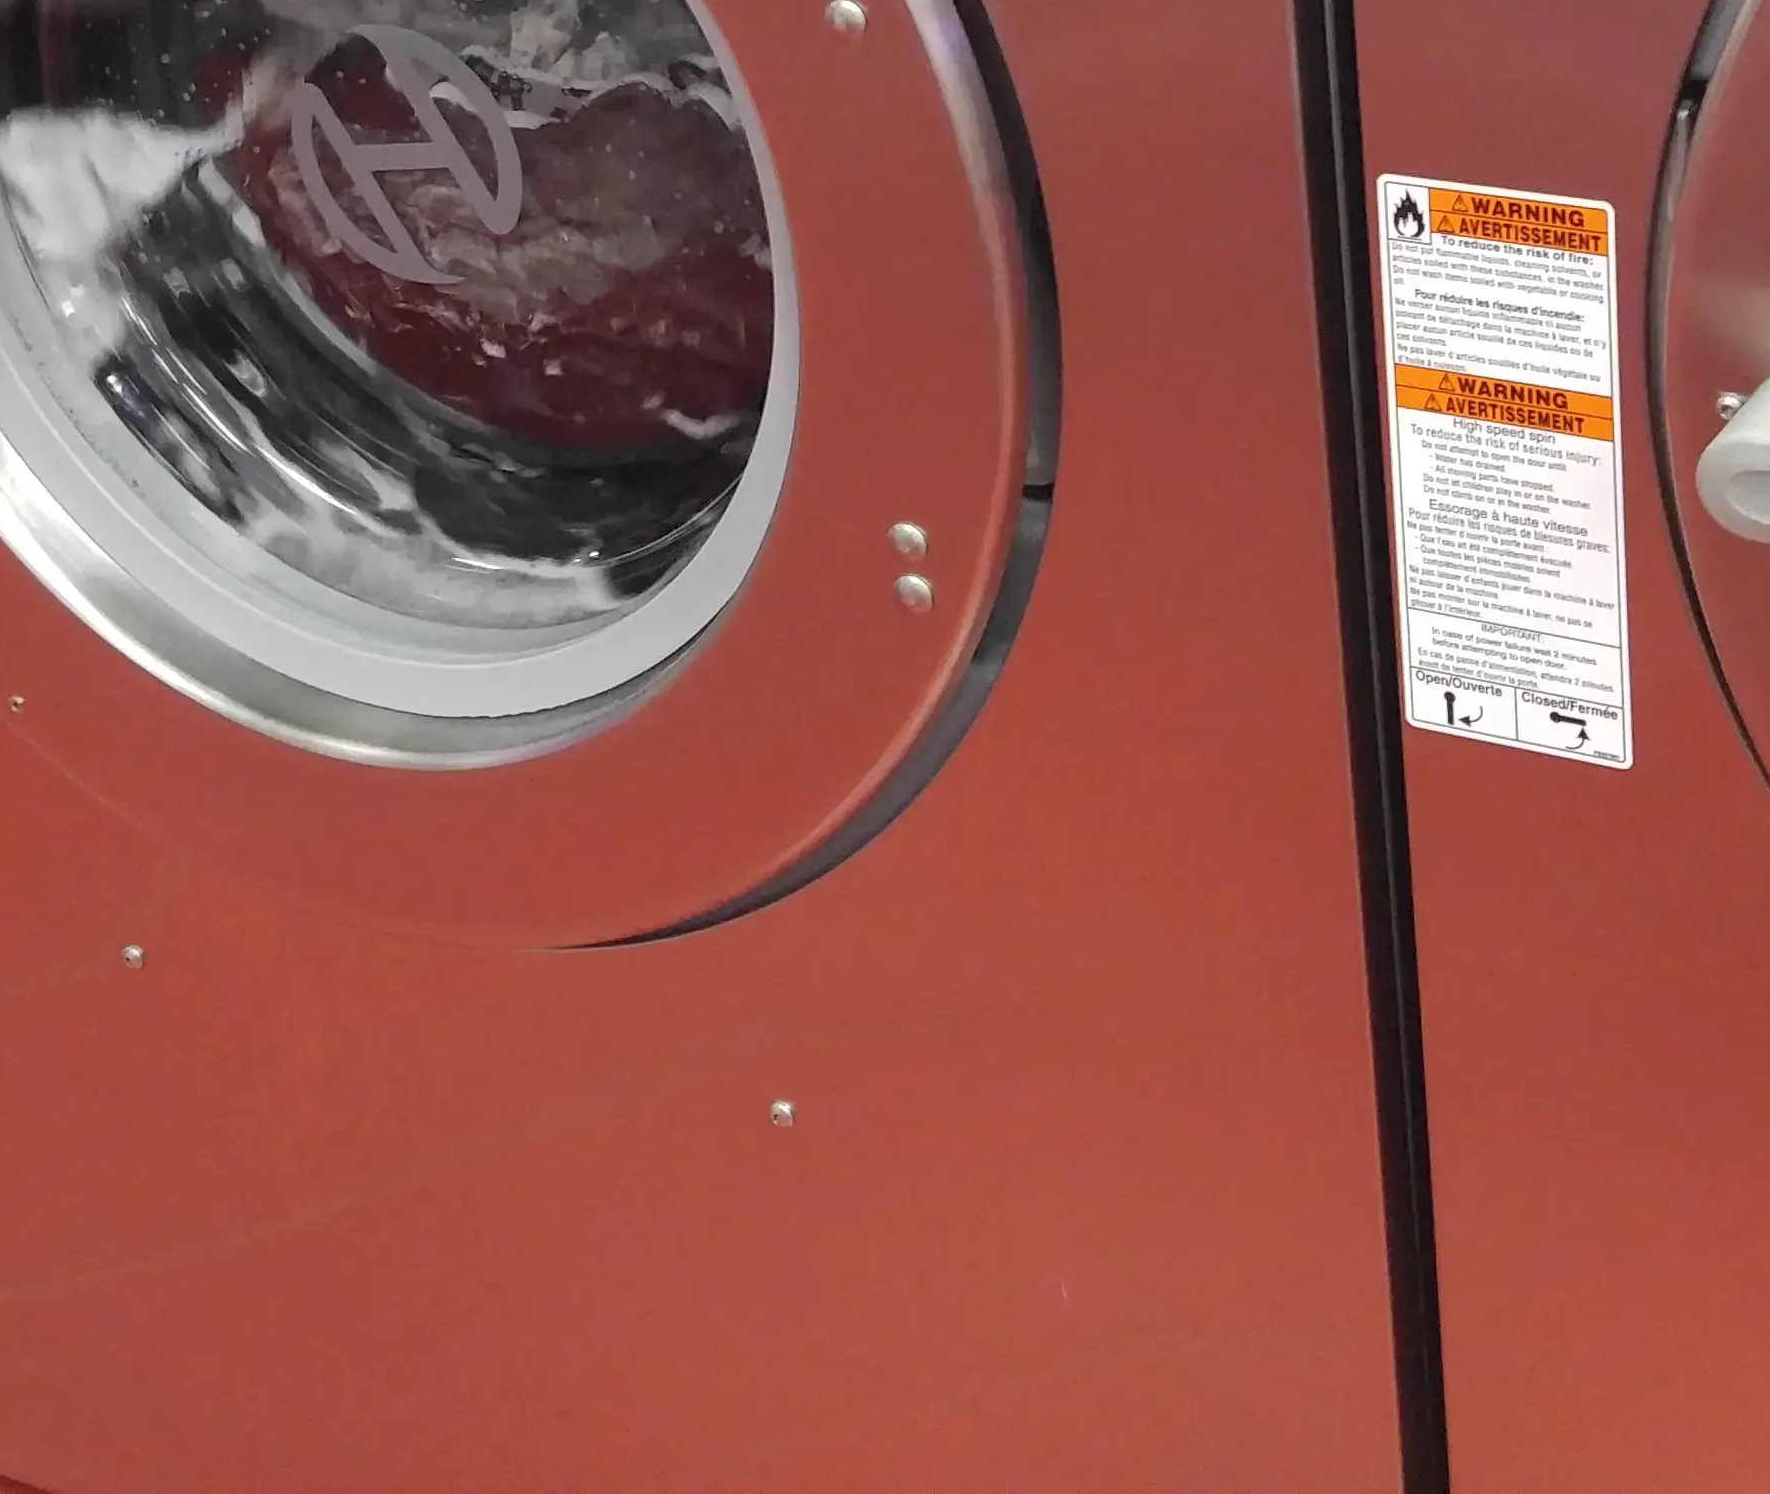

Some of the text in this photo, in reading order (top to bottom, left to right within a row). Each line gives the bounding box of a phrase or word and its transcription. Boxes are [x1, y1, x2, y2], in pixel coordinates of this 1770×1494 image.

[1470, 197, 1584, 227] WARNING
[1458, 216, 1601, 252] AVERTISSEMENT
[1440, 235, 1594, 265] To reduce the risk of fire:
[1414, 288, 1437, 300] Pour
[1439, 291, 1473, 306] réduire
[1475, 297, 1490, 308] les
[1492, 299, 1528, 316] risques
[1457, 376, 1568, 409] WARNING
[1445, 396, 1584, 434] AVERTISSEMENT
[1410, 423, 1423, 435] To
[1425, 426, 1462, 442] reduce
[1465, 432, 1481, 445] the
[1485, 435, 1505, 449] risk
[1508, 439, 1519, 451] of
[1522, 441, 1562, 459] serious
[1453, 417, 1555, 446] High speed spin
[1408, 507, 1430, 521] Pour
[1432, 511, 1464, 527] réduire
[1467, 517, 1480, 530] les
[1483, 521, 1517, 537] risques
[1519, 527, 1531, 539] de
[1428, 497, 1588, 537] Essorage à haute vitesse
[1432, 627, 1440, 635] In
[1475, 636, 1502, 648] power
[1415, 669, 1502, 699] Open/Ouverte
[1521, 690, 1618, 721] Closed/Fermée
